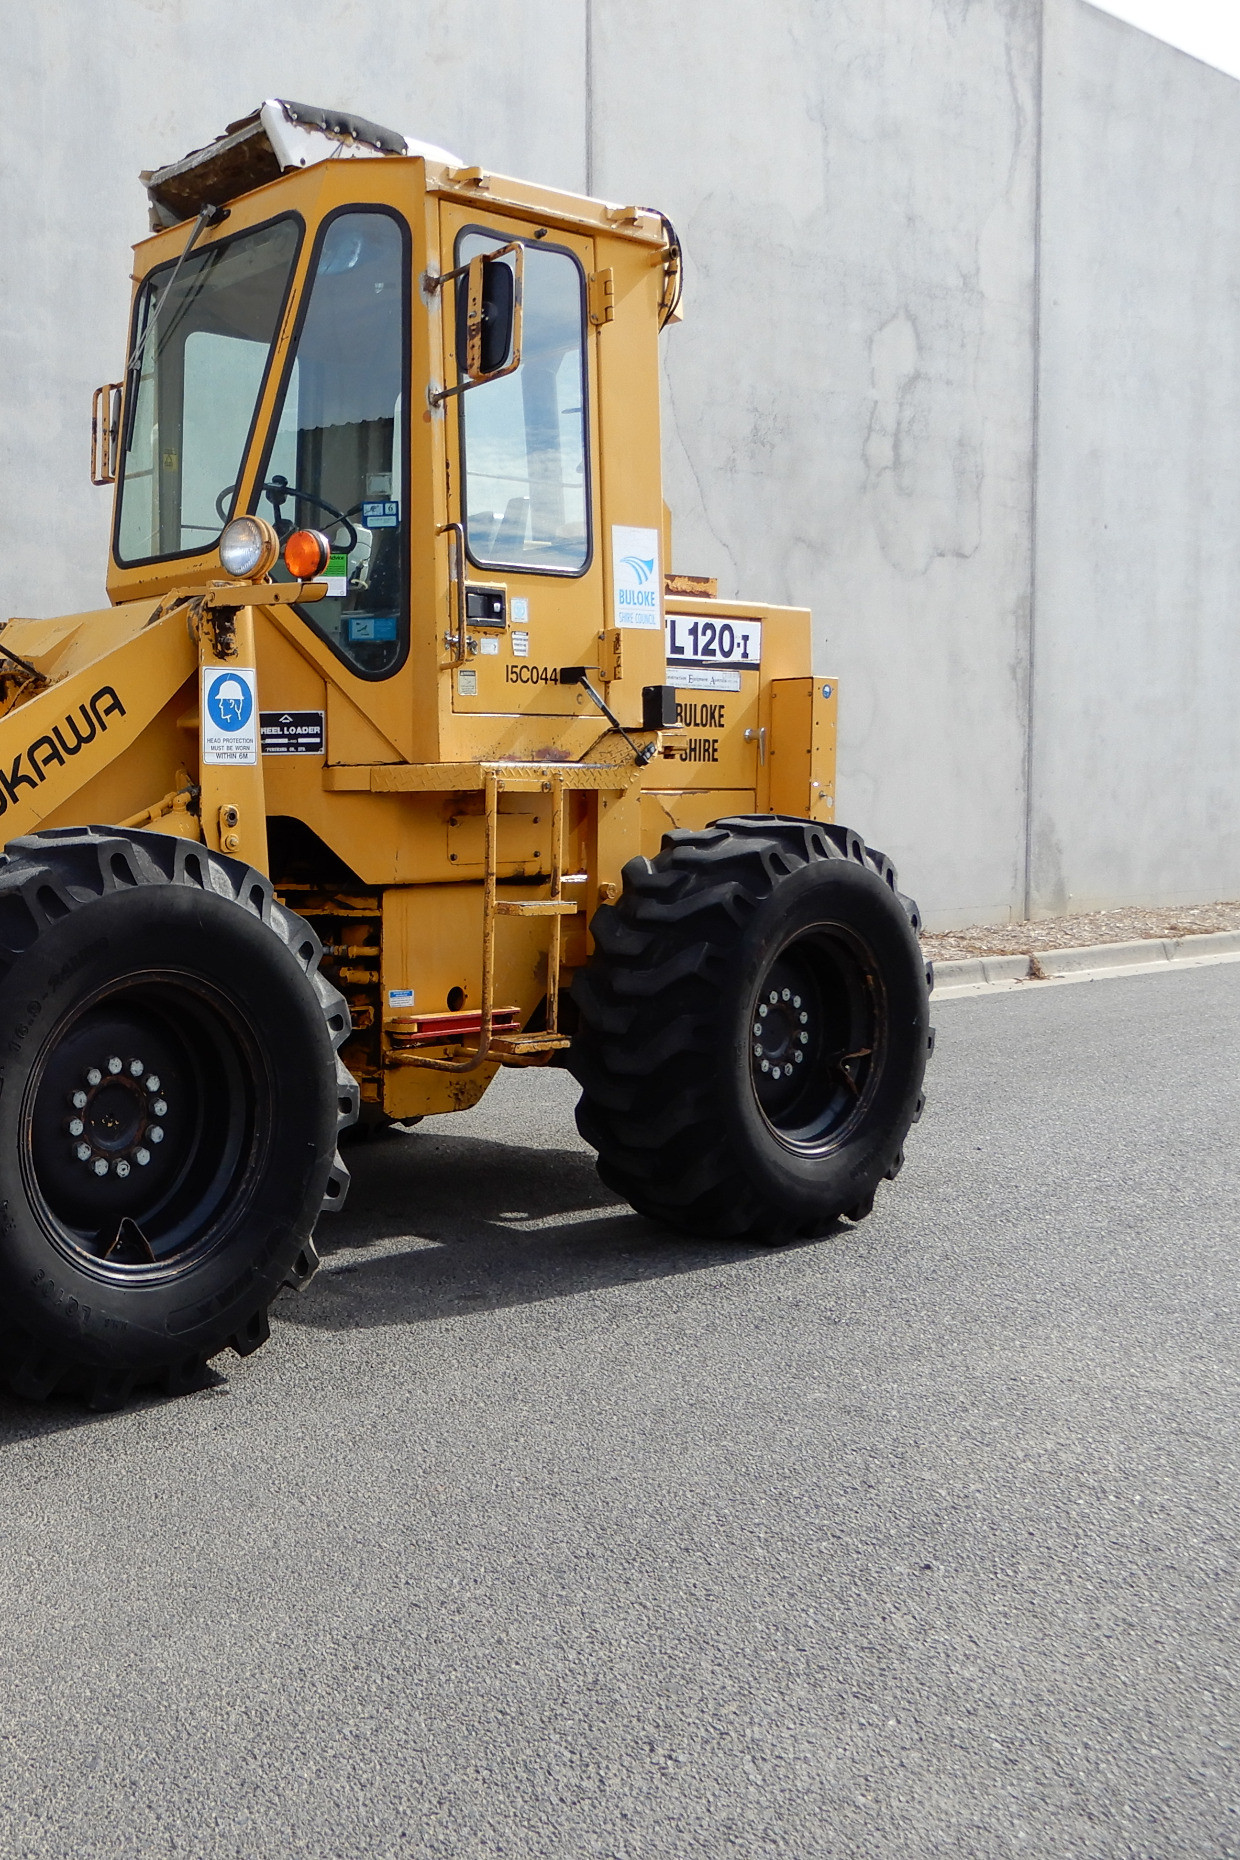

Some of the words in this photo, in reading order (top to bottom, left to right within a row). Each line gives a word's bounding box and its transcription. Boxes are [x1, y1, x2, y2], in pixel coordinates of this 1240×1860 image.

[619, 588, 656, 607] BULOKE
[665, 619, 750, 659] L120-I
[675, 702, 726, 728] BULOKE
[260, 726, 283, 735] HEEL
[284, 726, 321, 735] LOADER
[215, 752, 237, 760] WITHIN
